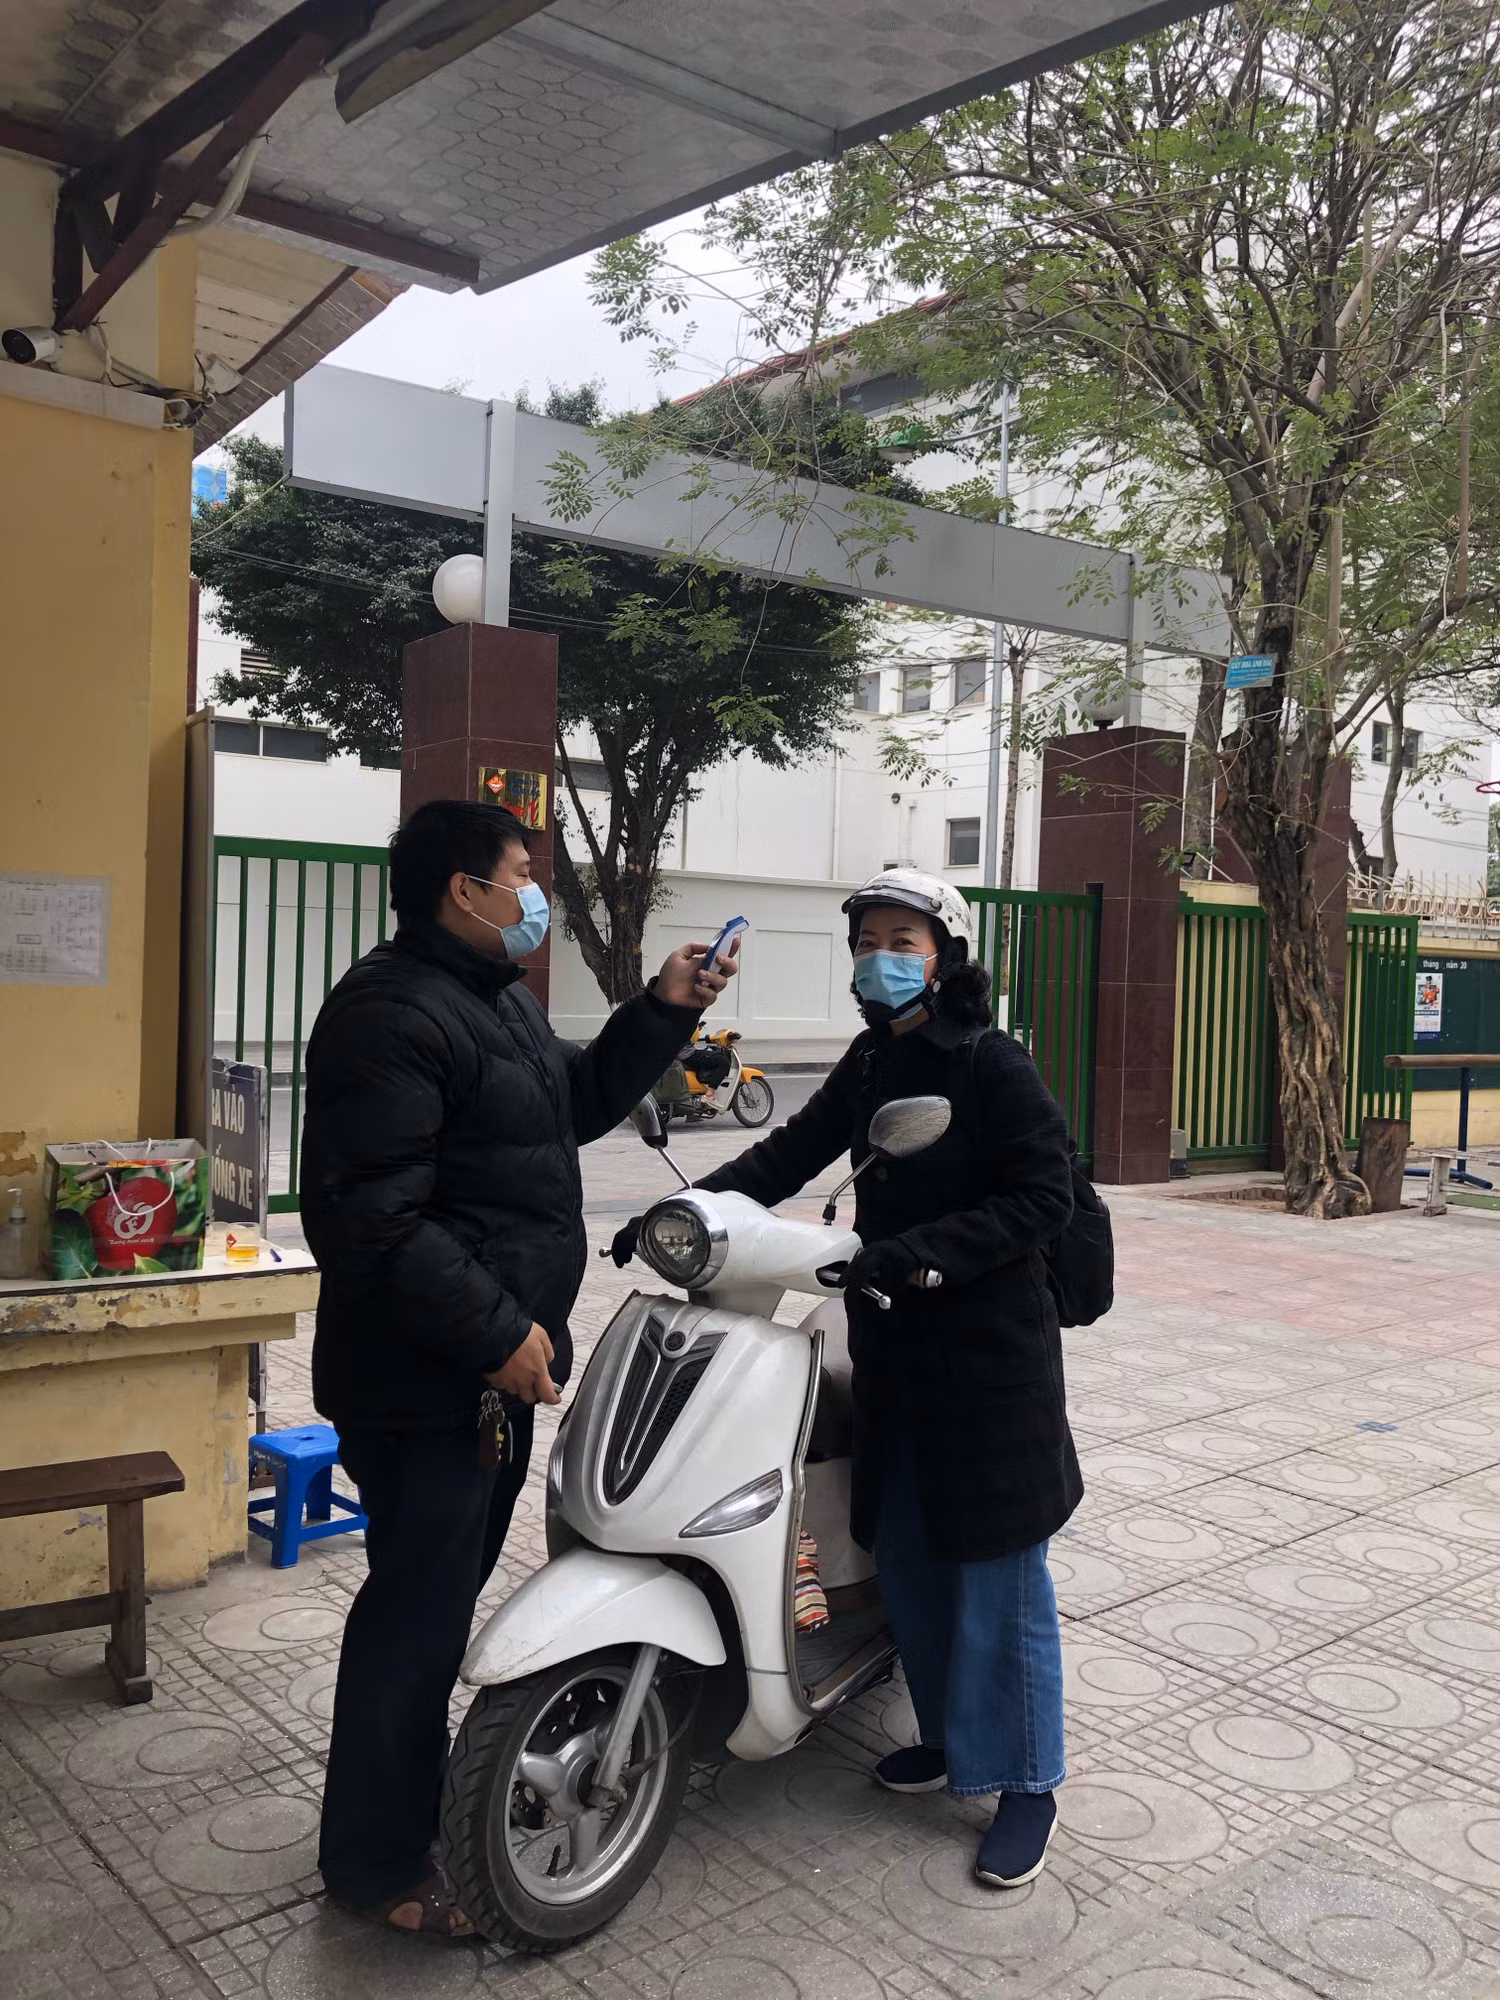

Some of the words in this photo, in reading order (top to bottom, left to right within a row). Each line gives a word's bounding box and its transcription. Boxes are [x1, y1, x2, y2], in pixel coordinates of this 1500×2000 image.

[1423, 959, 1439, 970] tháng
[1460, 961, 1467, 969] 20
[223, 1084, 245, 1135] VÀO
[238, 1165, 253, 1210] XE
